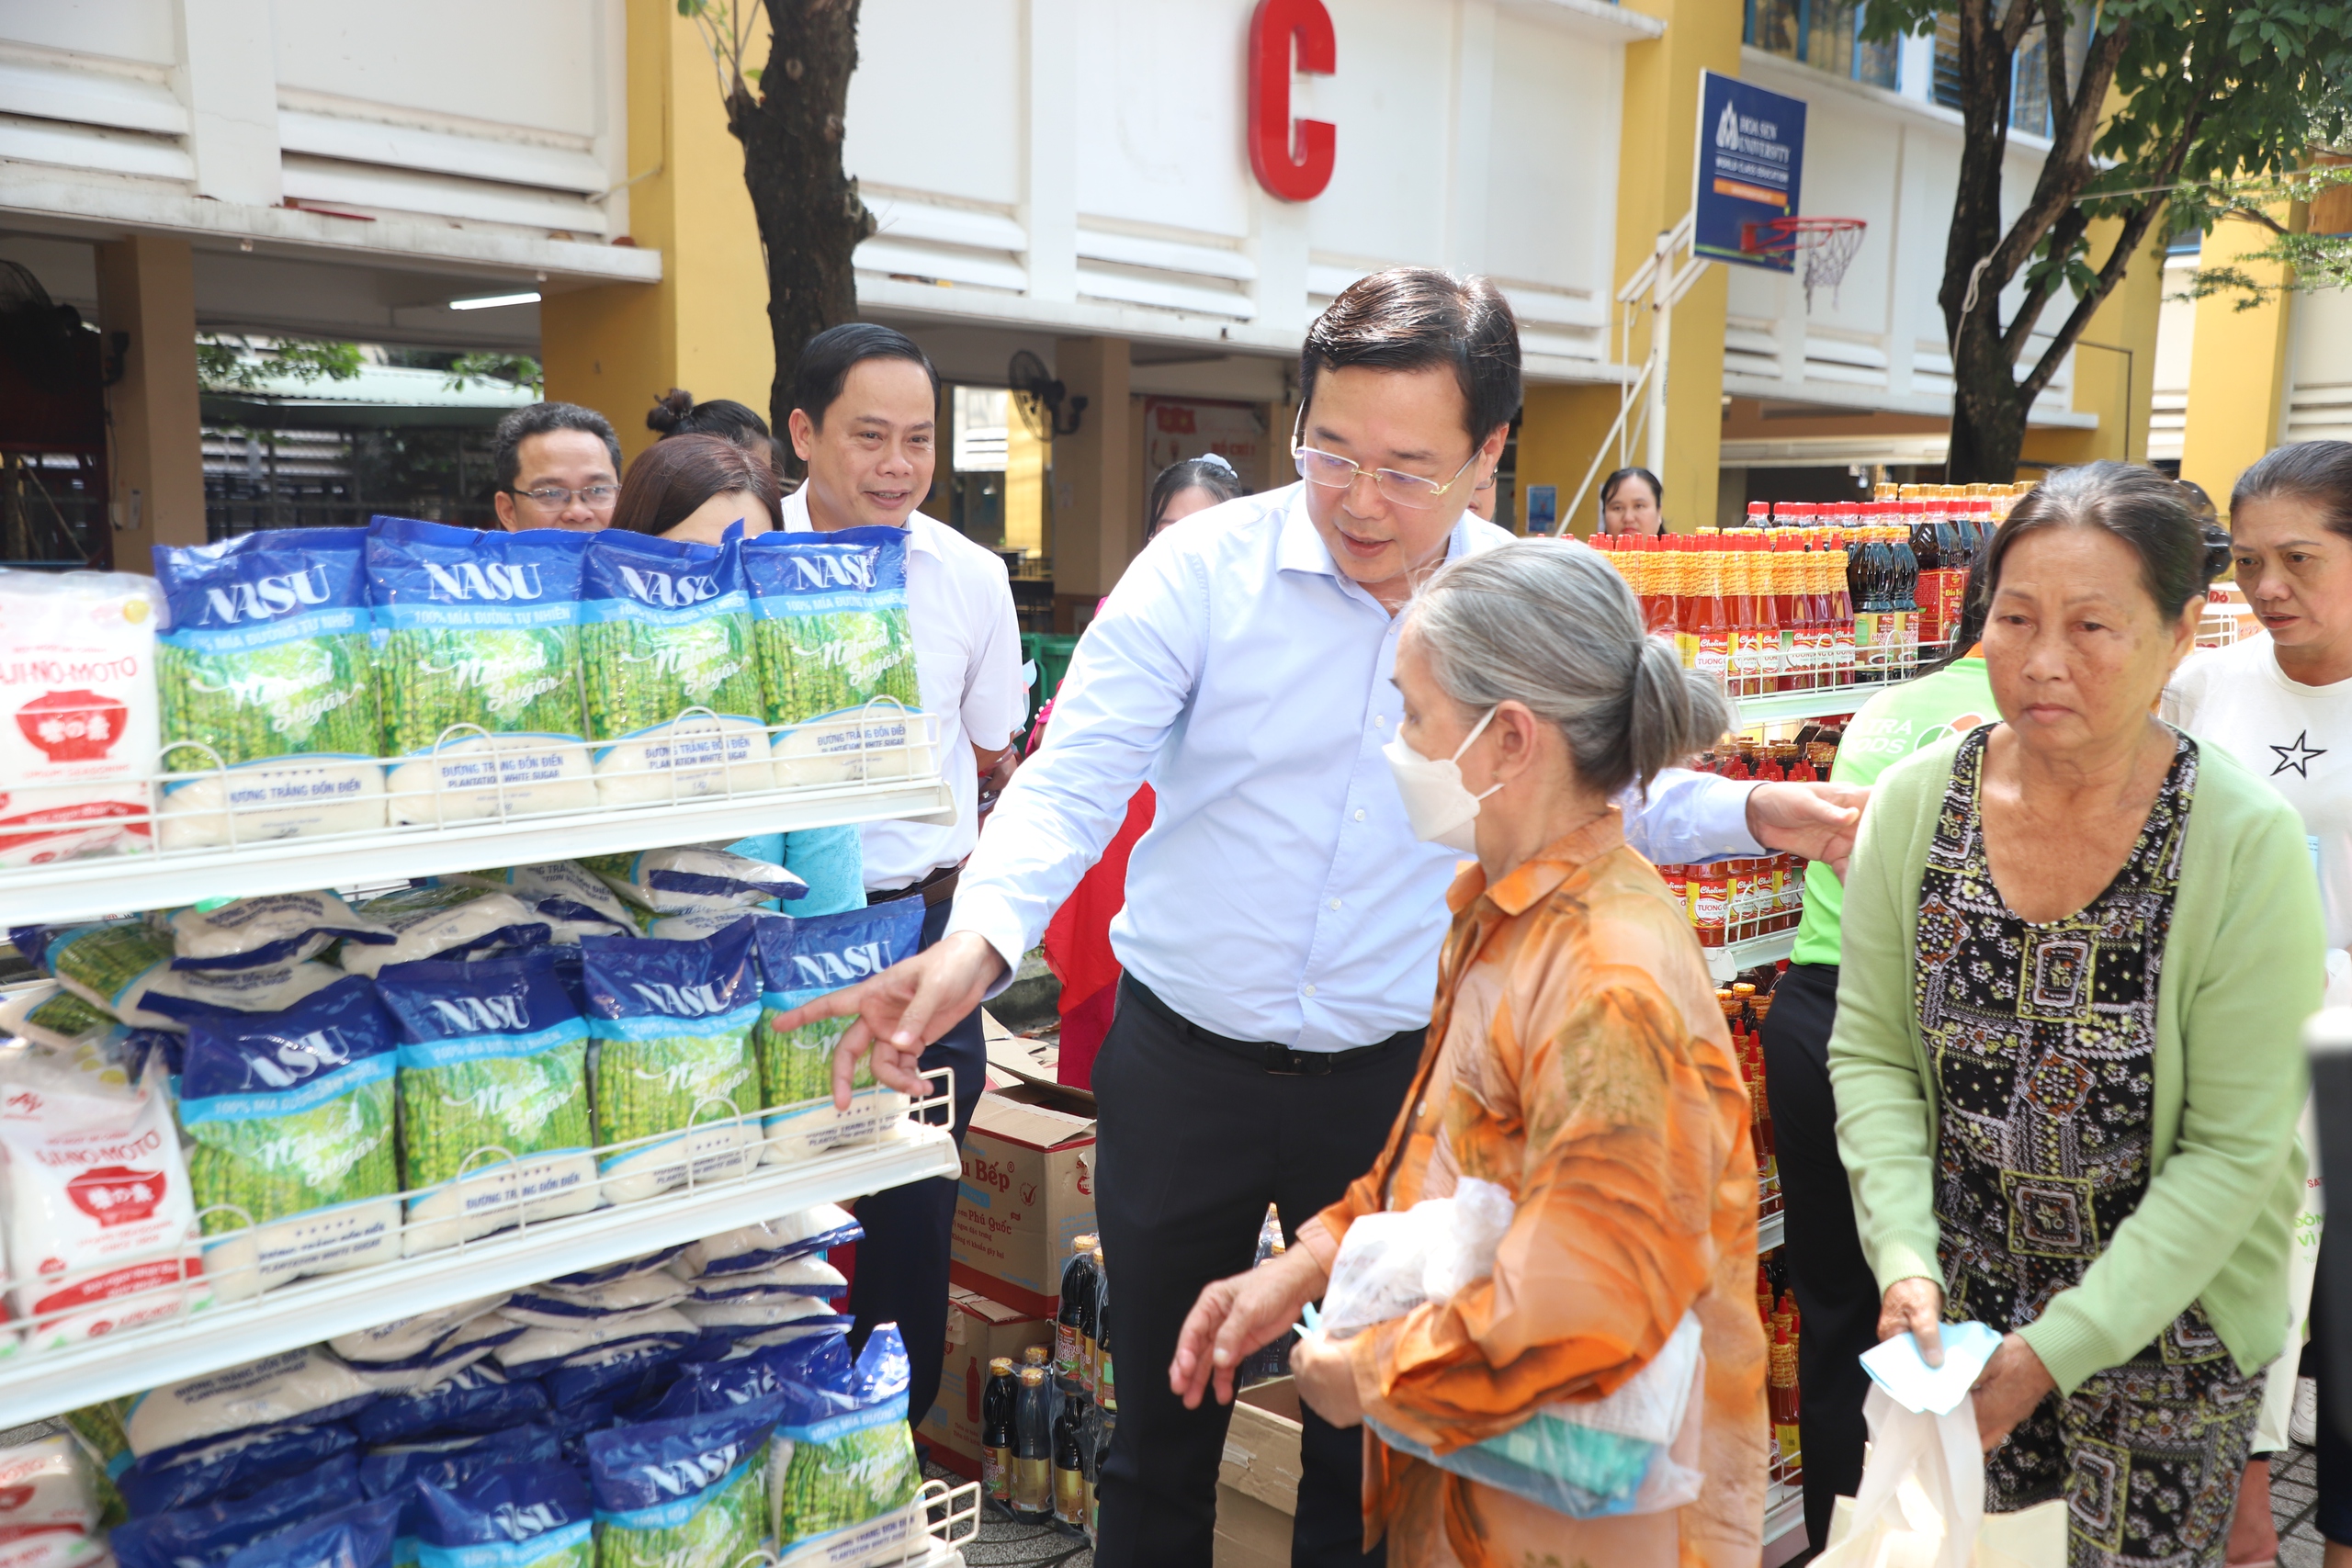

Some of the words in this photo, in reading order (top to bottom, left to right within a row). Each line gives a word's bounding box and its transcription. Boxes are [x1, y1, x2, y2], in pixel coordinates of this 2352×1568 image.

[1248, 0, 1336, 203] C
[423, 563, 543, 601] NASU
[619, 566, 719, 606] NASU
[790, 555, 876, 591] NASU
[198, 564, 331, 626] NASU
[786, 600, 812, 612] 100%
[813, 596, 834, 611] MÍA
[415, 611, 447, 626] 100%
[447, 610, 471, 626] MÍA
[475, 607, 514, 626] ĐƯỜNG
[533, 605, 571, 624] NHIÊN
[620, 626, 731, 680] Natural
[792, 622, 890, 671] Natural
[848, 646, 909, 687] Sugar
[418, 642, 548, 692] Natural
[684, 656, 752, 696] Sugar
[272, 683, 366, 733] Sugar
[487, 671, 572, 713] Sugar
[650, 756, 697, 769] PLANATION
[699, 752, 723, 763] WHITE
[726, 750, 748, 761] UGAR
[884, 738, 905, 747] SUGAR
[448, 774, 501, 788] PLANTATIO
[504, 772, 531, 784] WHITE
[533, 769, 560, 781] SUGAR
[482, 760, 516, 773] TRNG
[792, 941, 893, 986] NASU
[431, 995, 530, 1035] NASU
[630, 975, 731, 1017] NASU
[503, 1184, 537, 1201] TRNG
[975, 1158, 1010, 1193] Bếp
[968, 1209, 986, 1226] Phú
[989, 1216, 1012, 1235] Quốc
